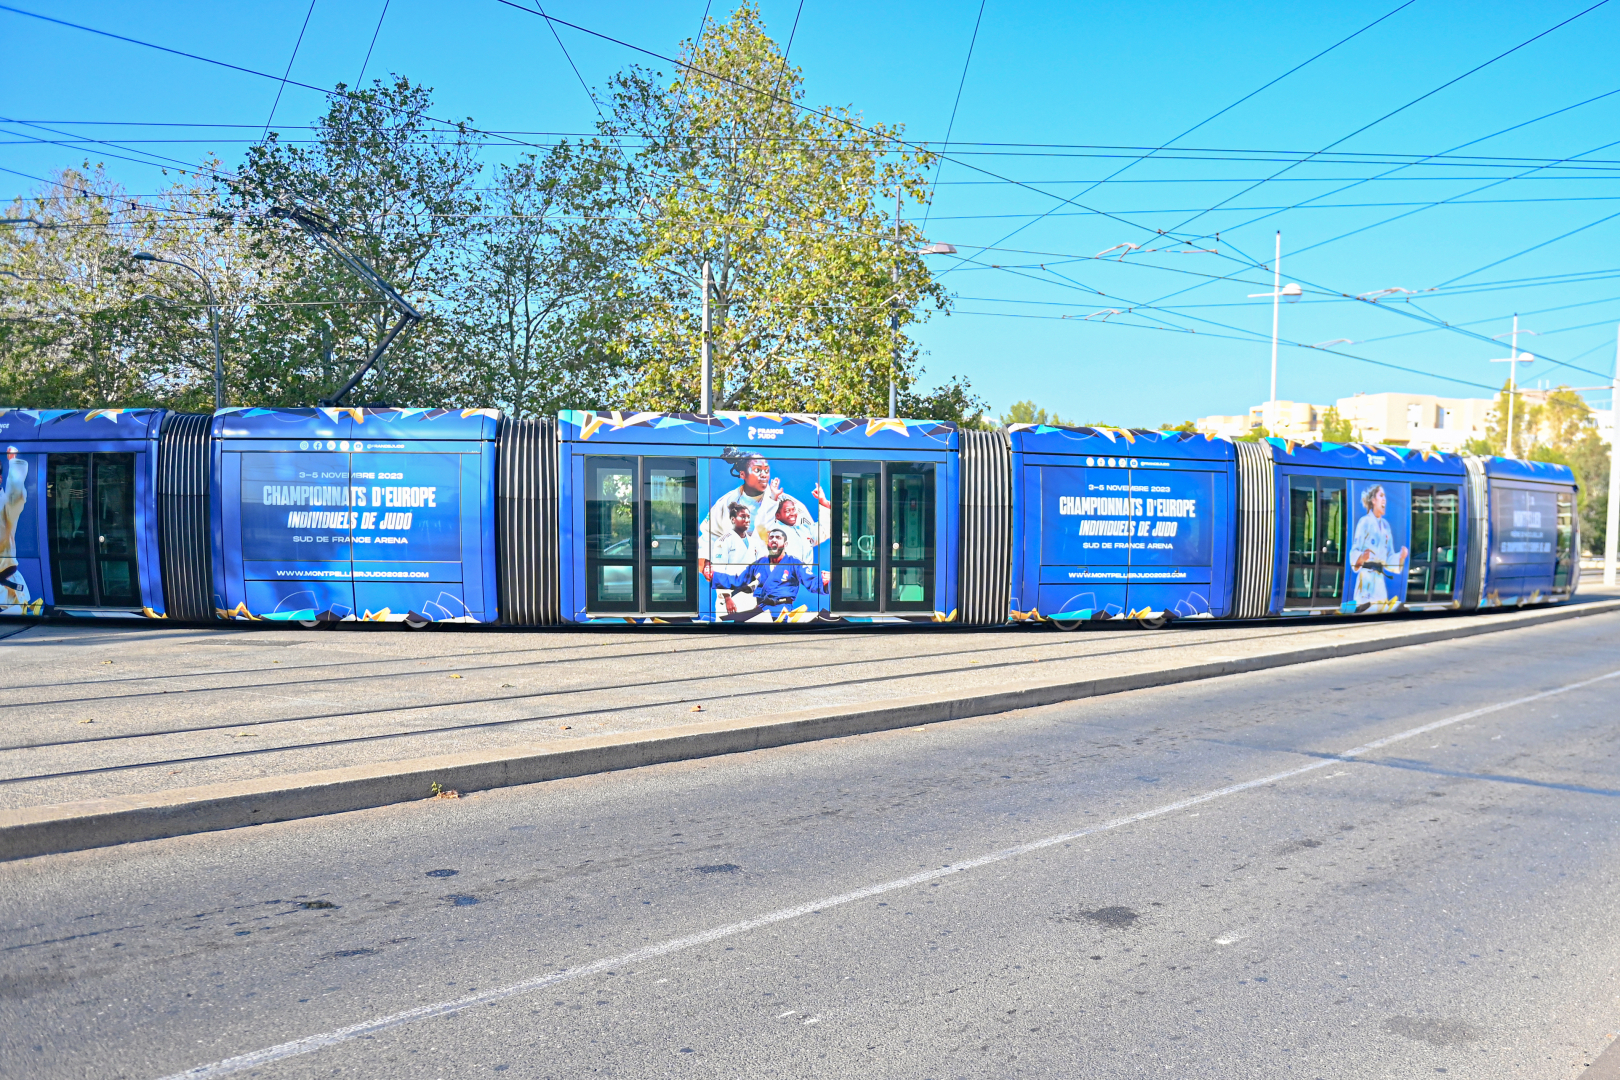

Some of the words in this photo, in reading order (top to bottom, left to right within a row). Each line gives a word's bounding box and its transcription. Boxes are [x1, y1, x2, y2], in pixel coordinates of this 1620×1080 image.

[378, 472, 403, 480] 2023
[263, 485, 366, 507] CHAMPIONNATS
[372, 486, 437, 508] D'EUROPE
[1106, 484, 1149, 492] NOVEMBRE
[1059, 496, 1143, 516] CHAMPIONNATS
[1146, 498, 1196, 518] D'EUROPE
[287, 511, 358, 529] INDIVIDUELS
[360, 512, 377, 529] DE
[379, 512, 413, 530] JUDO
[1079, 520, 1136, 536] INDIVIDUELS
[1137, 521, 1151, 536] DE
[1152, 521, 1178, 537] JUDO
[331, 536, 371, 544] FRANCE
[374, 536, 409, 544] ARENA
